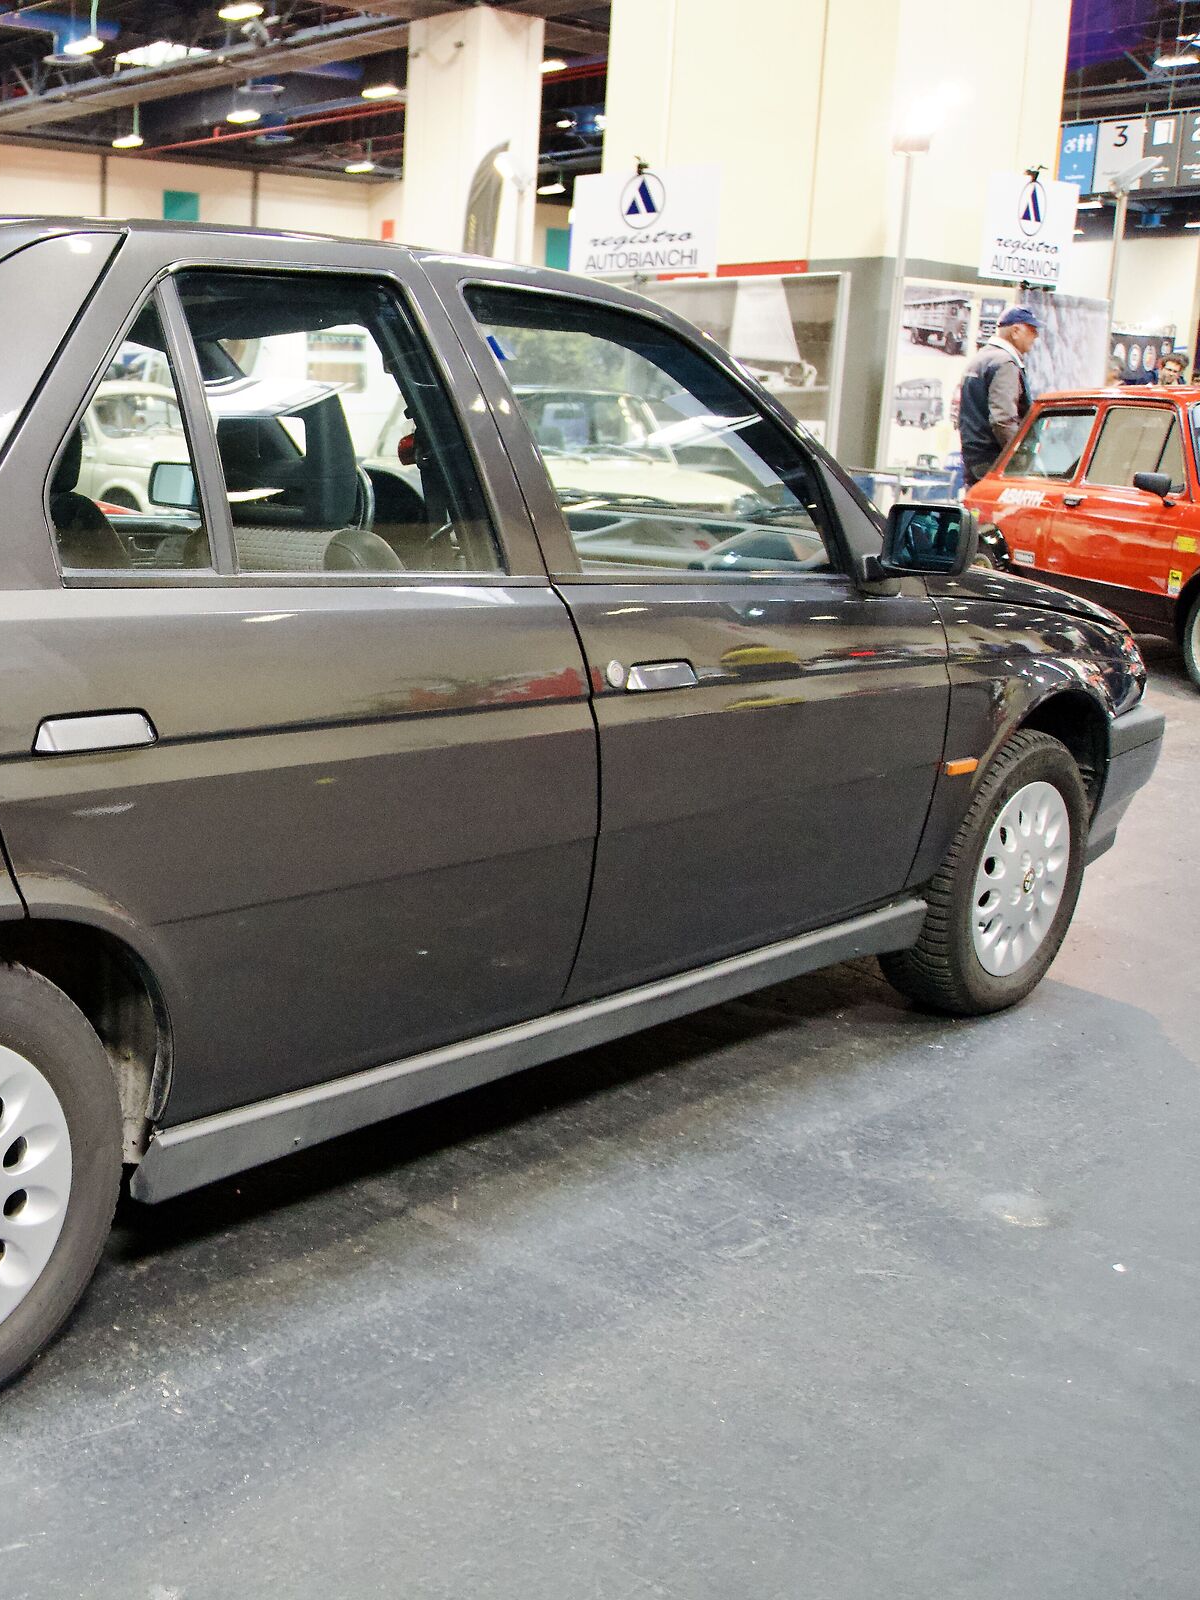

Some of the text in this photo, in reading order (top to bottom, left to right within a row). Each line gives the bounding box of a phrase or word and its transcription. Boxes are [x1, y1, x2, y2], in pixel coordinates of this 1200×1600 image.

[1113, 125, 1129, 148] 3
[590, 230, 692, 251] registro
[996, 237, 1058, 254] registro
[584, 248, 698, 270] AUTOBIANCHI
[991, 254, 1060, 278] AUTOBIANCHI
[997, 487, 1046, 508] ABARTH
